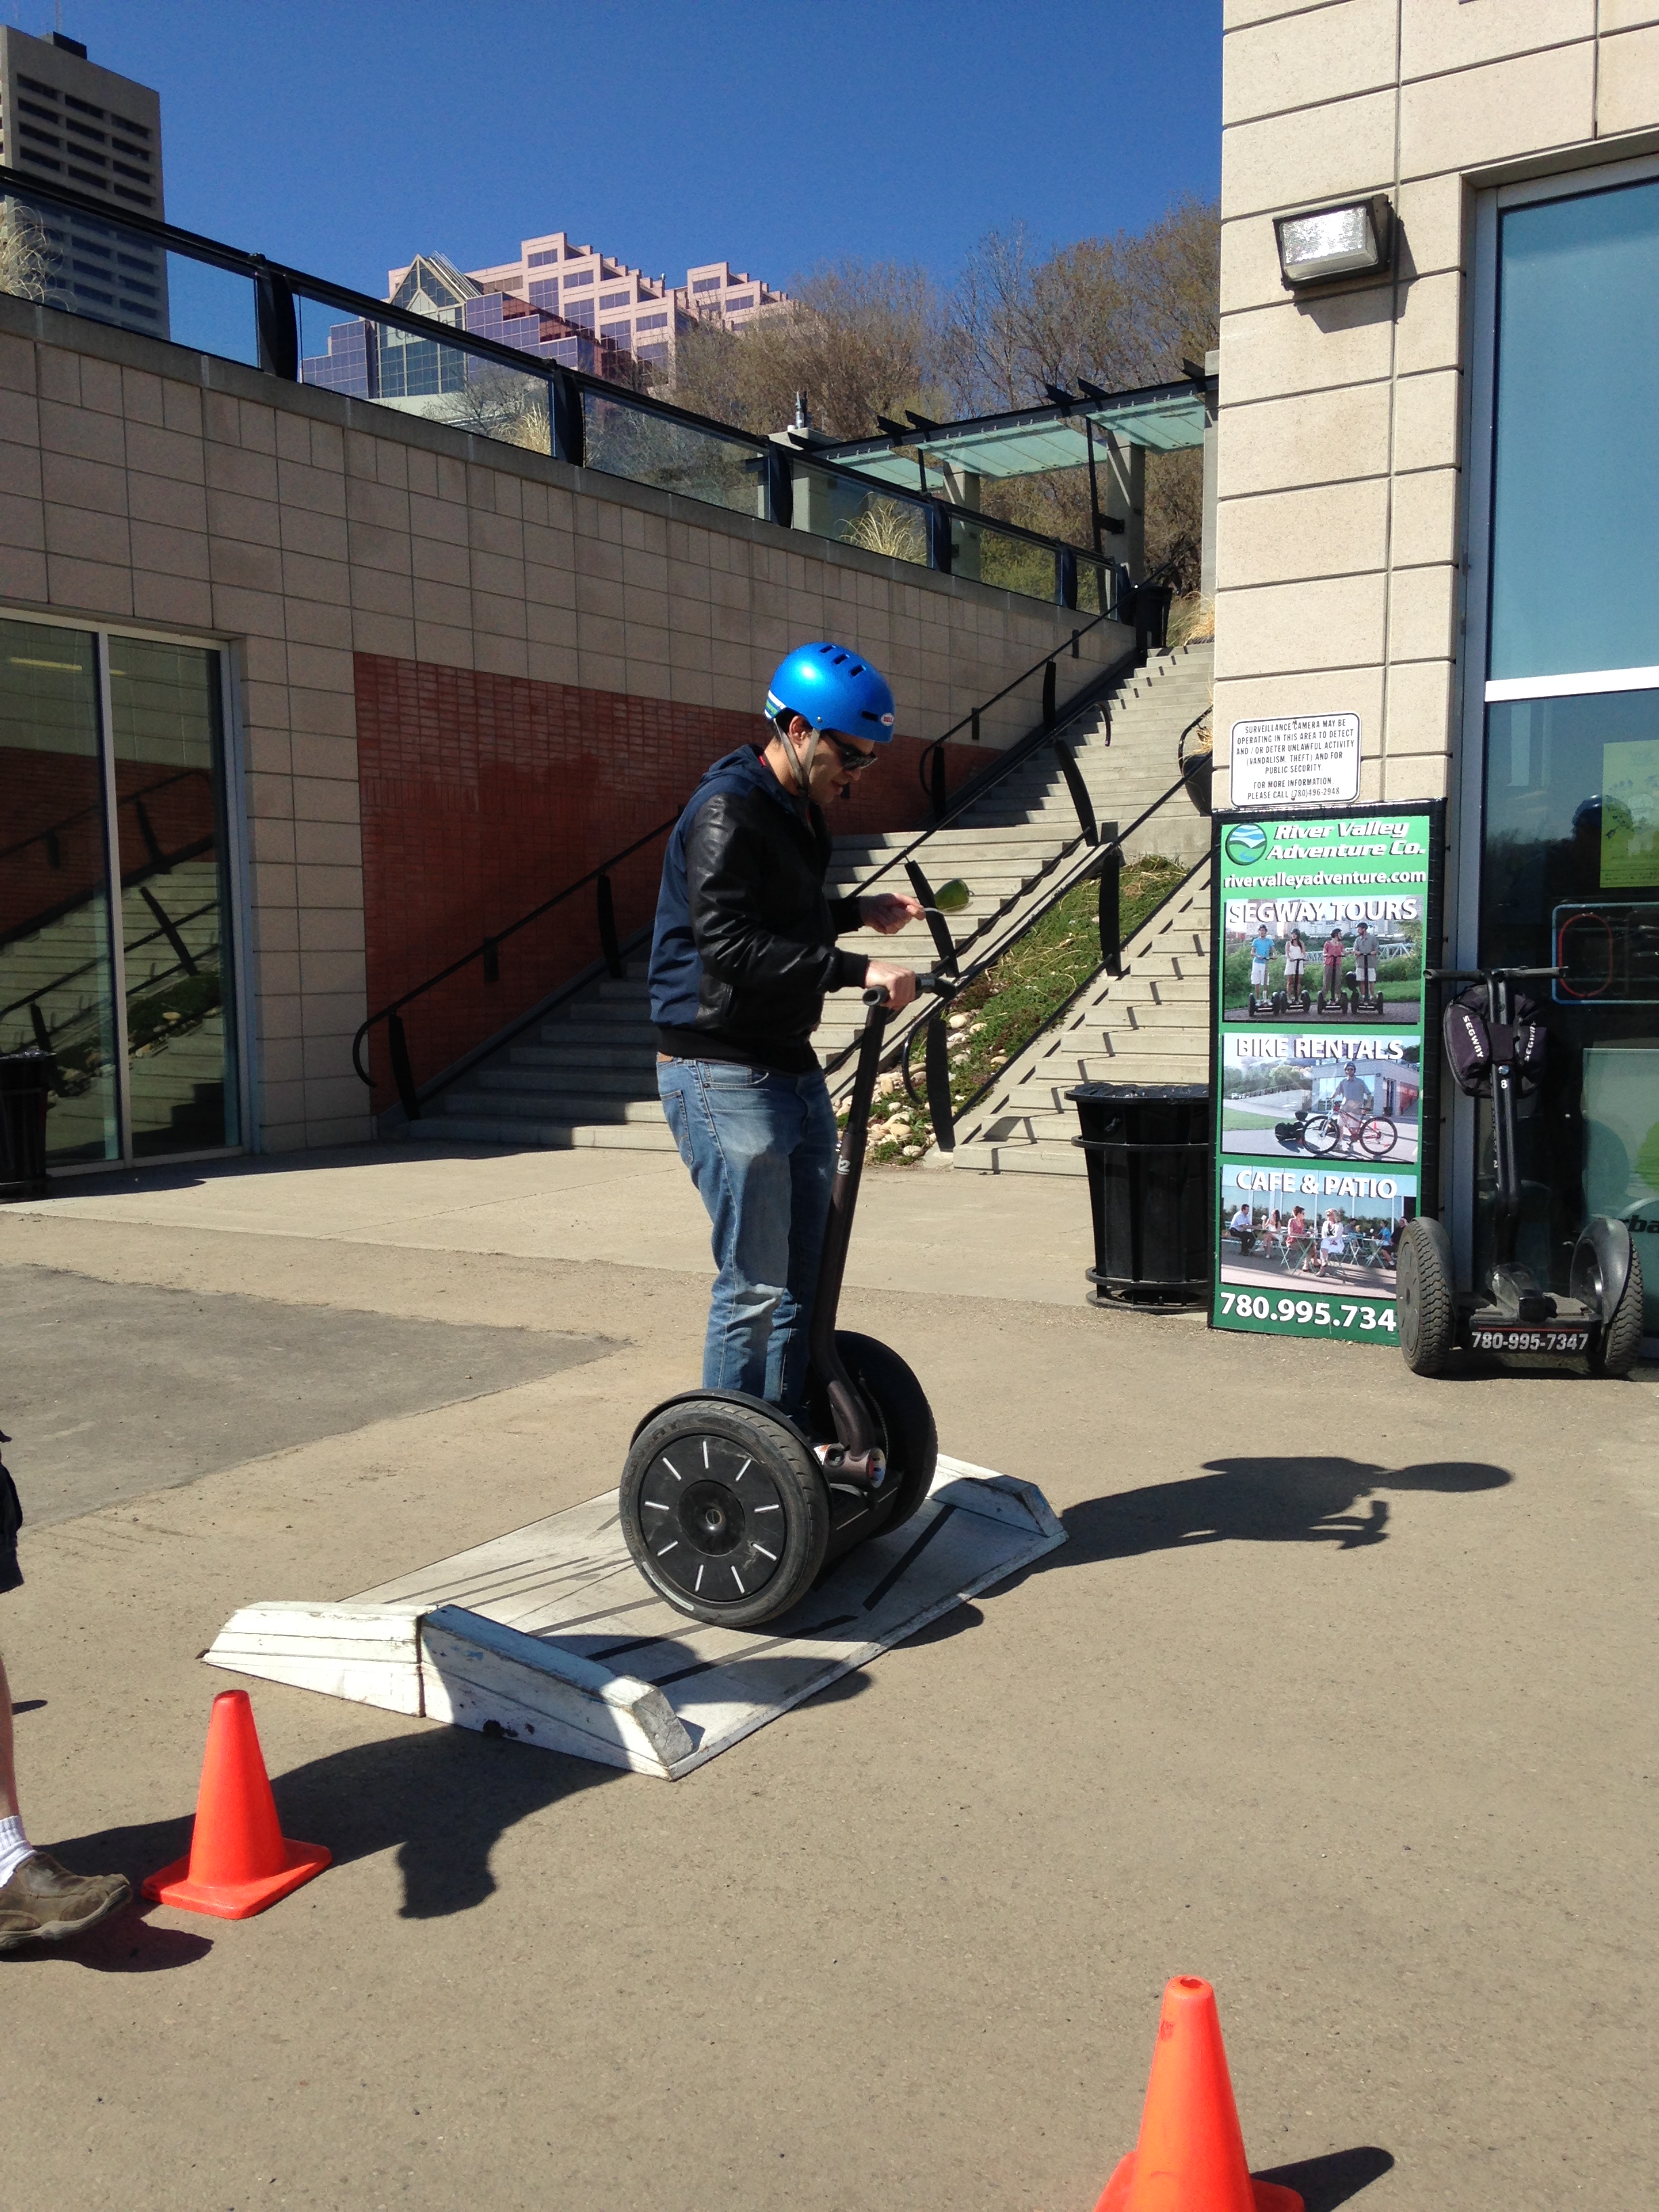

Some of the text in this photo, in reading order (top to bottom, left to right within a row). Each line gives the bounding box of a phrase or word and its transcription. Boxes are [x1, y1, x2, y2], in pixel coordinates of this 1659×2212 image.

[1245, 723, 1291, 733] SURVEILLANCE
[1293, 720, 1319, 730] CAMERA
[1323, 720, 1335, 728] MAY
[1237, 735, 1272, 745] OPERATING
[1284, 733, 1297, 741] THIS
[1300, 732, 1316, 740] AREA
[1319, 731, 1327, 739] TO
[1329, 729, 1353, 738] DETECT
[1236, 747, 1248, 756] AND
[1266, 745, 1286, 754] DETER
[1288, 742, 1322, 752] UNLAWFUL
[1324, 740, 1354, 749] ACTIVITY
[1290, 754, 1313, 762] THEFT)
[1315, 752, 1328, 760] AND
[1330, 751, 1343, 759] FOR
[1265, 766, 1288, 774] PUBLIC
[1268, 779, 1286, 787] MORE
[1248, 787, 1340, 800] PLEASE CALL (780)496-2948
[1273, 820, 1410, 840] River Valley
[1265, 839, 1427, 861] Adventure Co.
[1223, 870, 1427, 890] rivervalleyadventure.com
[1229, 899, 1418, 924] SEGWAY TOURS
[1462, 1015, 1484, 1058] SEGWAY
[1524, 1020, 1536, 1062] SEGWAY
[1237, 1038, 1404, 1060] BIKE RENTALS
[1500, 1080, 1508, 1089] 8
[1236, 1170, 1398, 1199] CAFE & PATIO
[1220, 1292, 1399, 1332] 780.995.734
[1471, 1331, 1589, 1351] 780-995-7347
